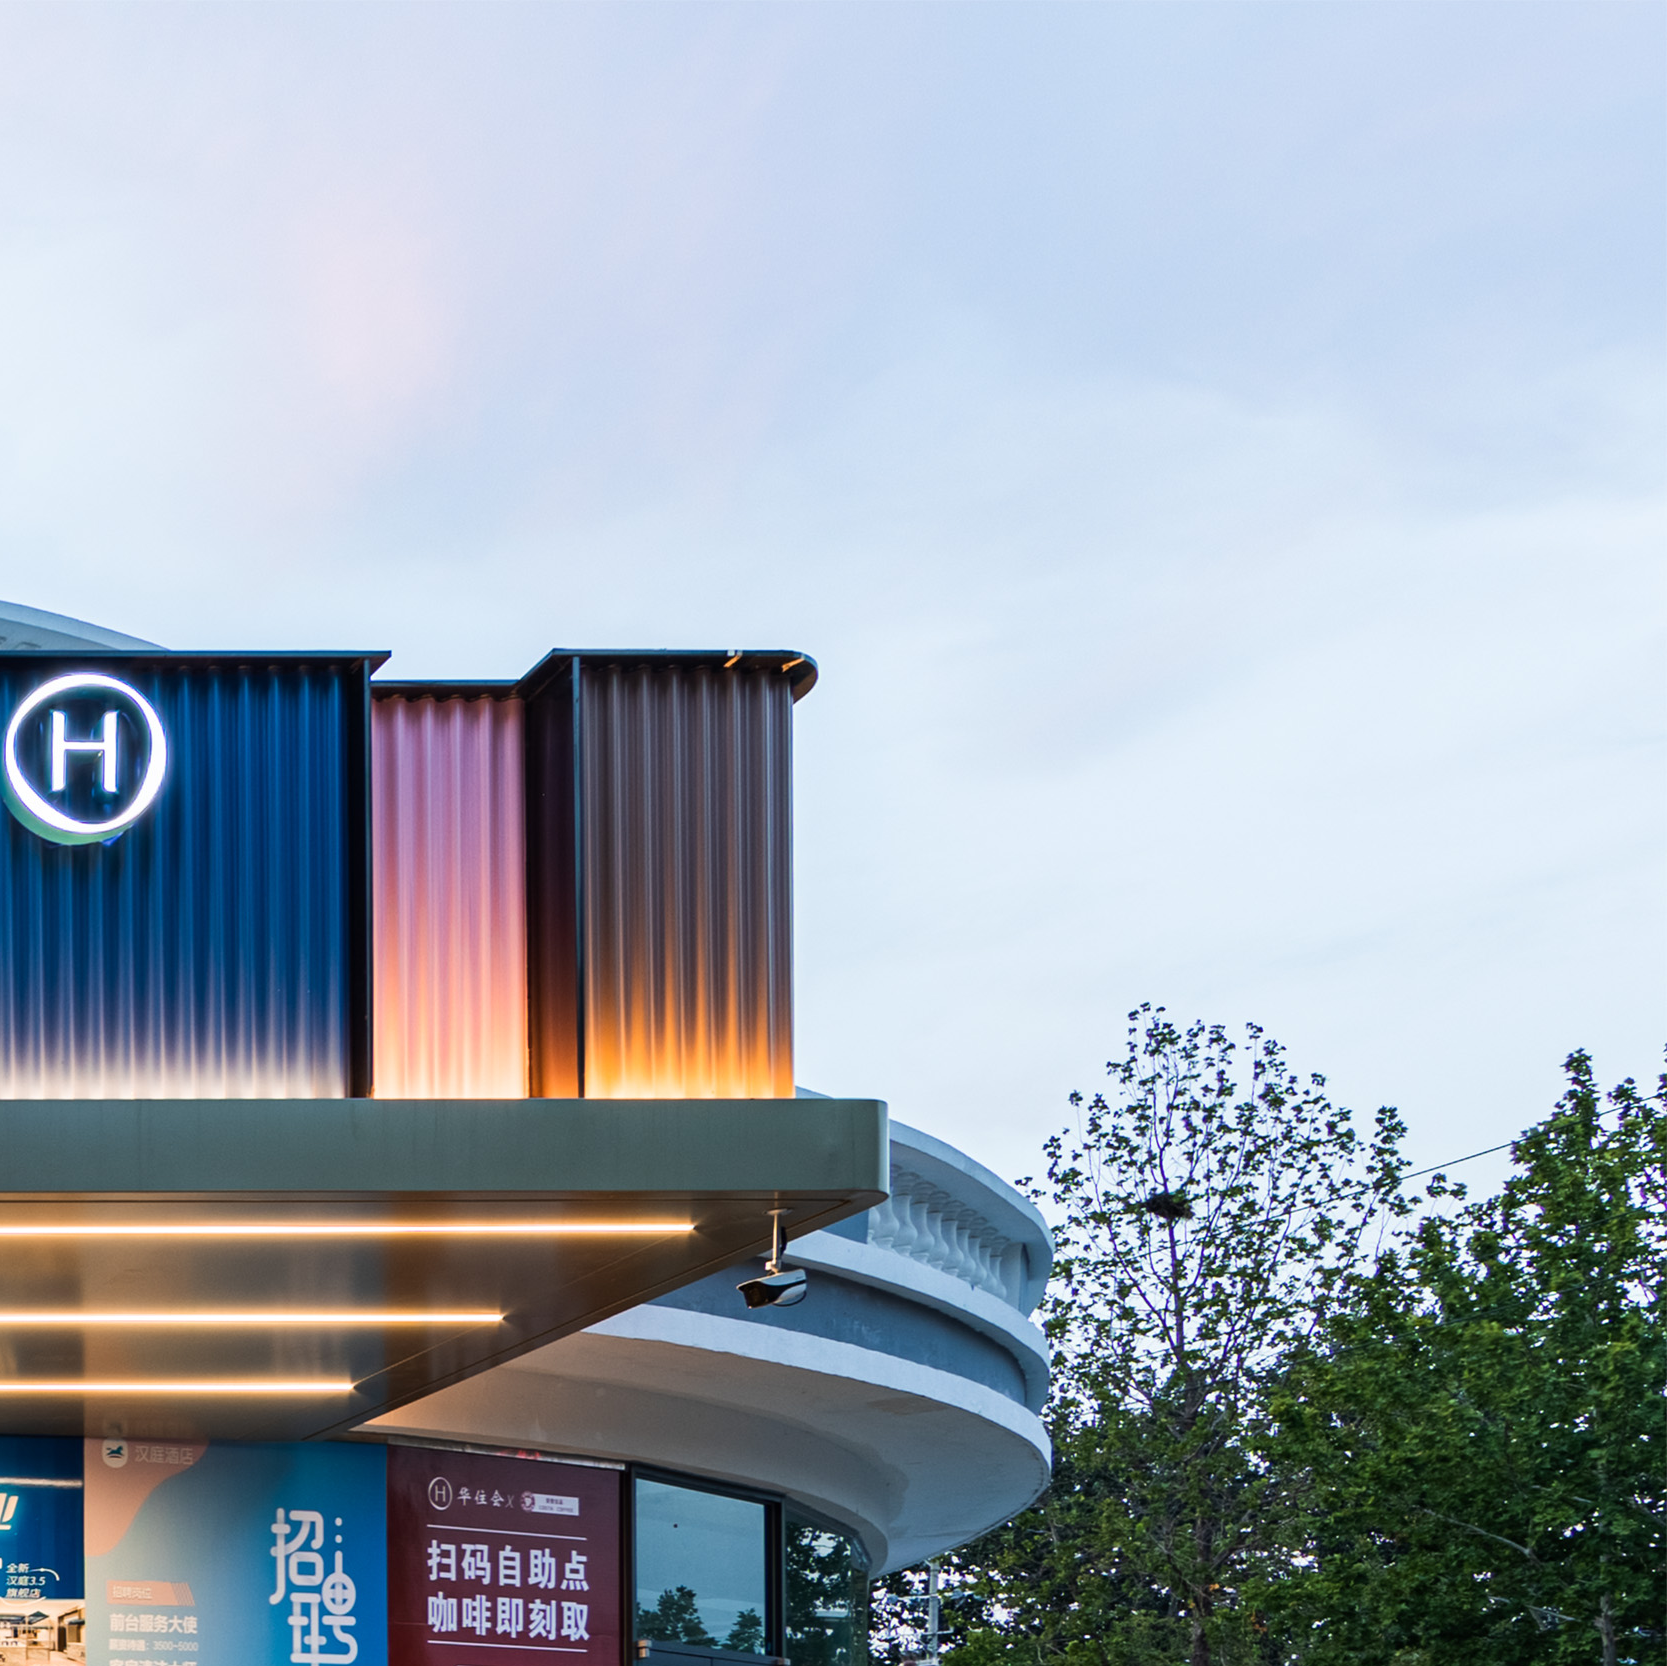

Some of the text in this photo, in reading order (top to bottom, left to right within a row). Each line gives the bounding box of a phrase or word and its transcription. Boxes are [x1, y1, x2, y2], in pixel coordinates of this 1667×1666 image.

[134, 1445, 194, 1465] 汉庭酒店
[457, 1487, 504, 1507] 华住会
[5, 1562, 30, 1574] 全新
[427, 1540, 590, 1592] 扫码自助点
[109, 1613, 198, 1634] 前台服务大使
[427, 1592, 590, 1642] 咖啡即刻取
